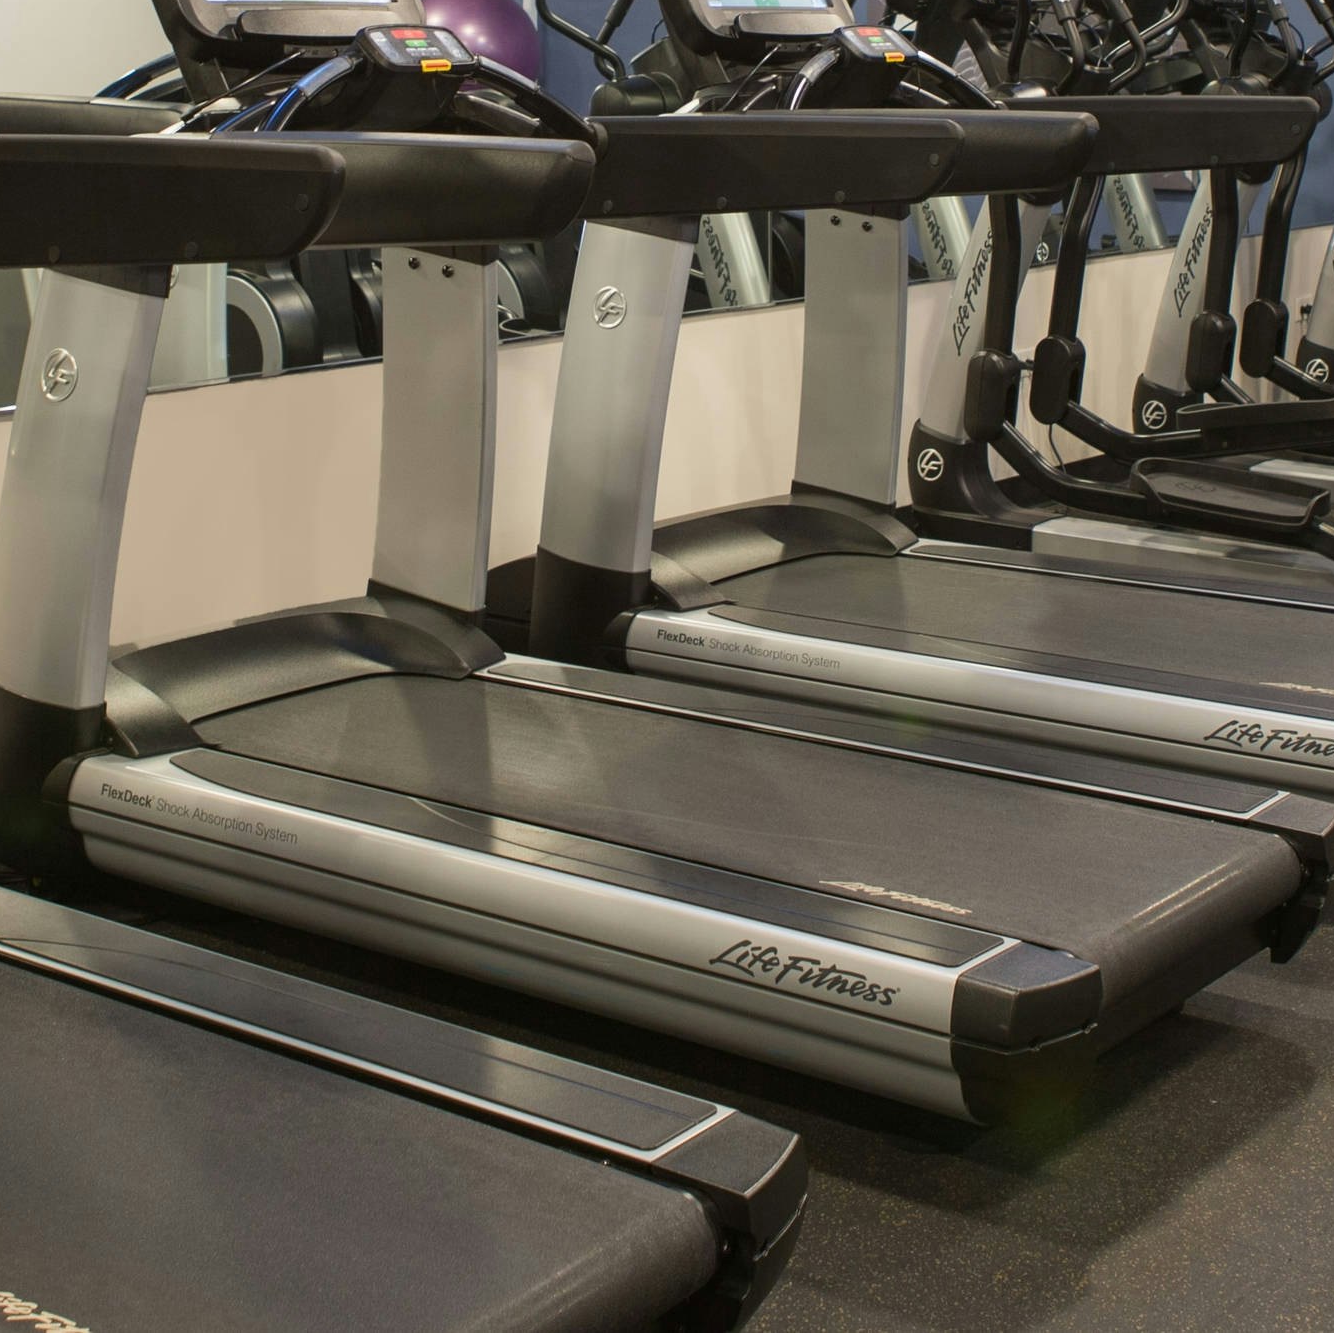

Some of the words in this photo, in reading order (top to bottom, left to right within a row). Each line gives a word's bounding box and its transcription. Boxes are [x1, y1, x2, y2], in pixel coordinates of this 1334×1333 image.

[657, 629, 706, 648] FlexDeck
[708, 637, 741, 654] Shock
[742, 643, 799, 663] Absorption
[800, 652, 841, 670] System
[100, 783, 153, 809] FlexDeck
[156, 798, 190, 819] Shock
[191, 807, 254, 834] Absorption
[254, 821, 299, 845] System
